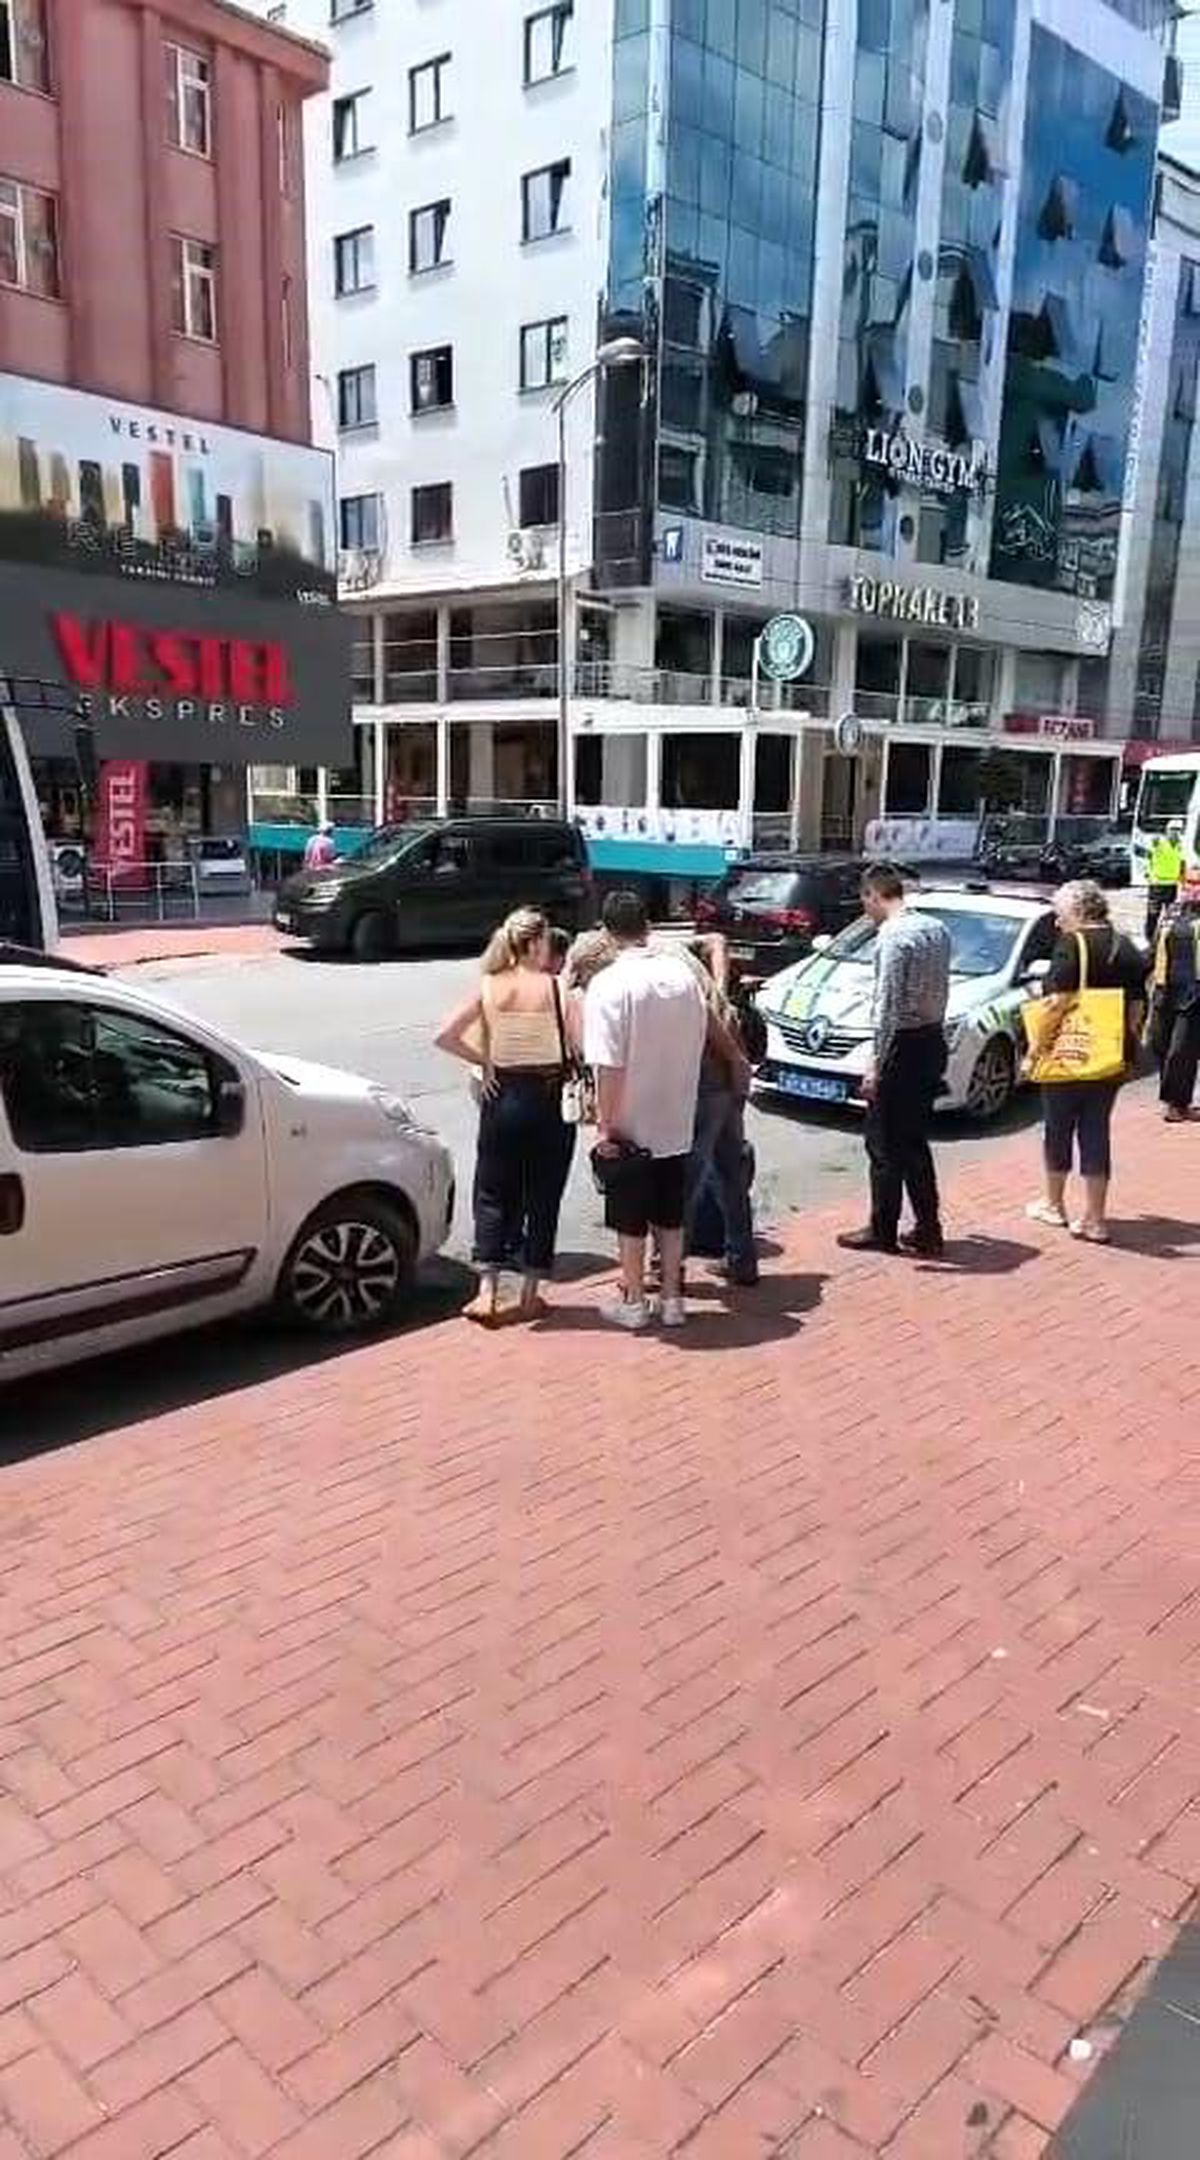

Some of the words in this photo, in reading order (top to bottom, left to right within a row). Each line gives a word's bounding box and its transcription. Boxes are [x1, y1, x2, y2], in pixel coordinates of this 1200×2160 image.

[109, 416, 209, 454] VESTEL
[866, 429, 924, 474] LION
[931, 449, 978, 488] GYM
[52, 611, 296, 708] VESTEL
[77, 694, 285, 729] EKSPRES
